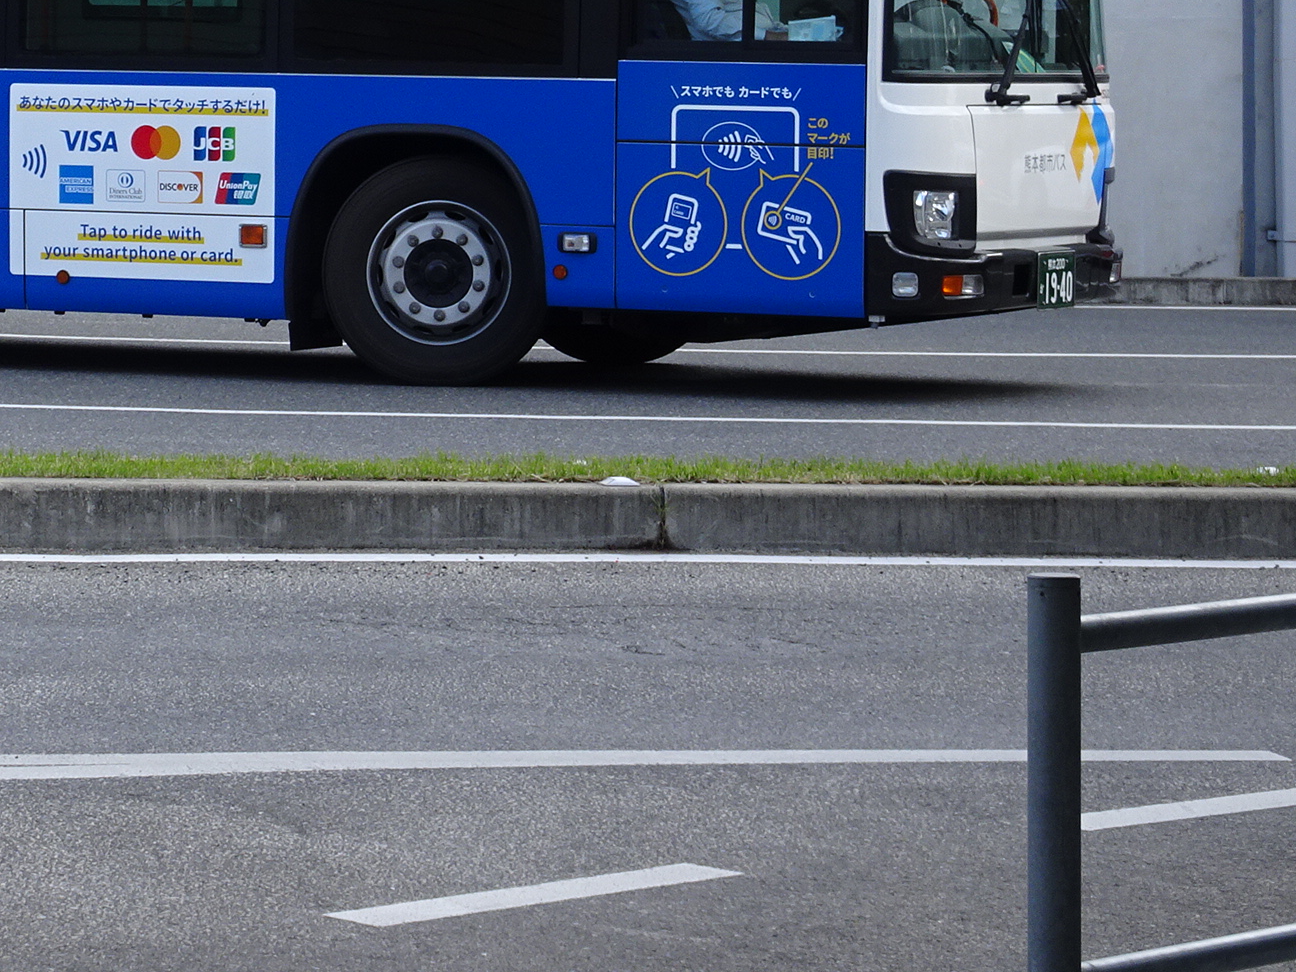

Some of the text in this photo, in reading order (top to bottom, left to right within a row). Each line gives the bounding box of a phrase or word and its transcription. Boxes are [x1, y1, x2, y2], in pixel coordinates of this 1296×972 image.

[680, 85, 793, 99] スマホでも カードでも
[19, 96, 265, 115] あなたのスマホやカードでタッチするだけ!
[808, 118, 829, 129] この
[60, 129, 118, 152] VISA
[807, 133, 851, 144] マークが
[807, 147, 834, 159] 目印!
[1024, 154, 1067, 174] 熊本都市バス
[60, 177, 92, 185] AMERICAN
[160, 182, 198, 192] DISCOVER
[219, 180, 258, 193] UnionPay
[128, 187, 142, 195] Club
[785, 212, 805, 224] CARD
[80, 224, 202, 241] Tap to ride with
[44, 245, 238, 263] your smartphone or card.
